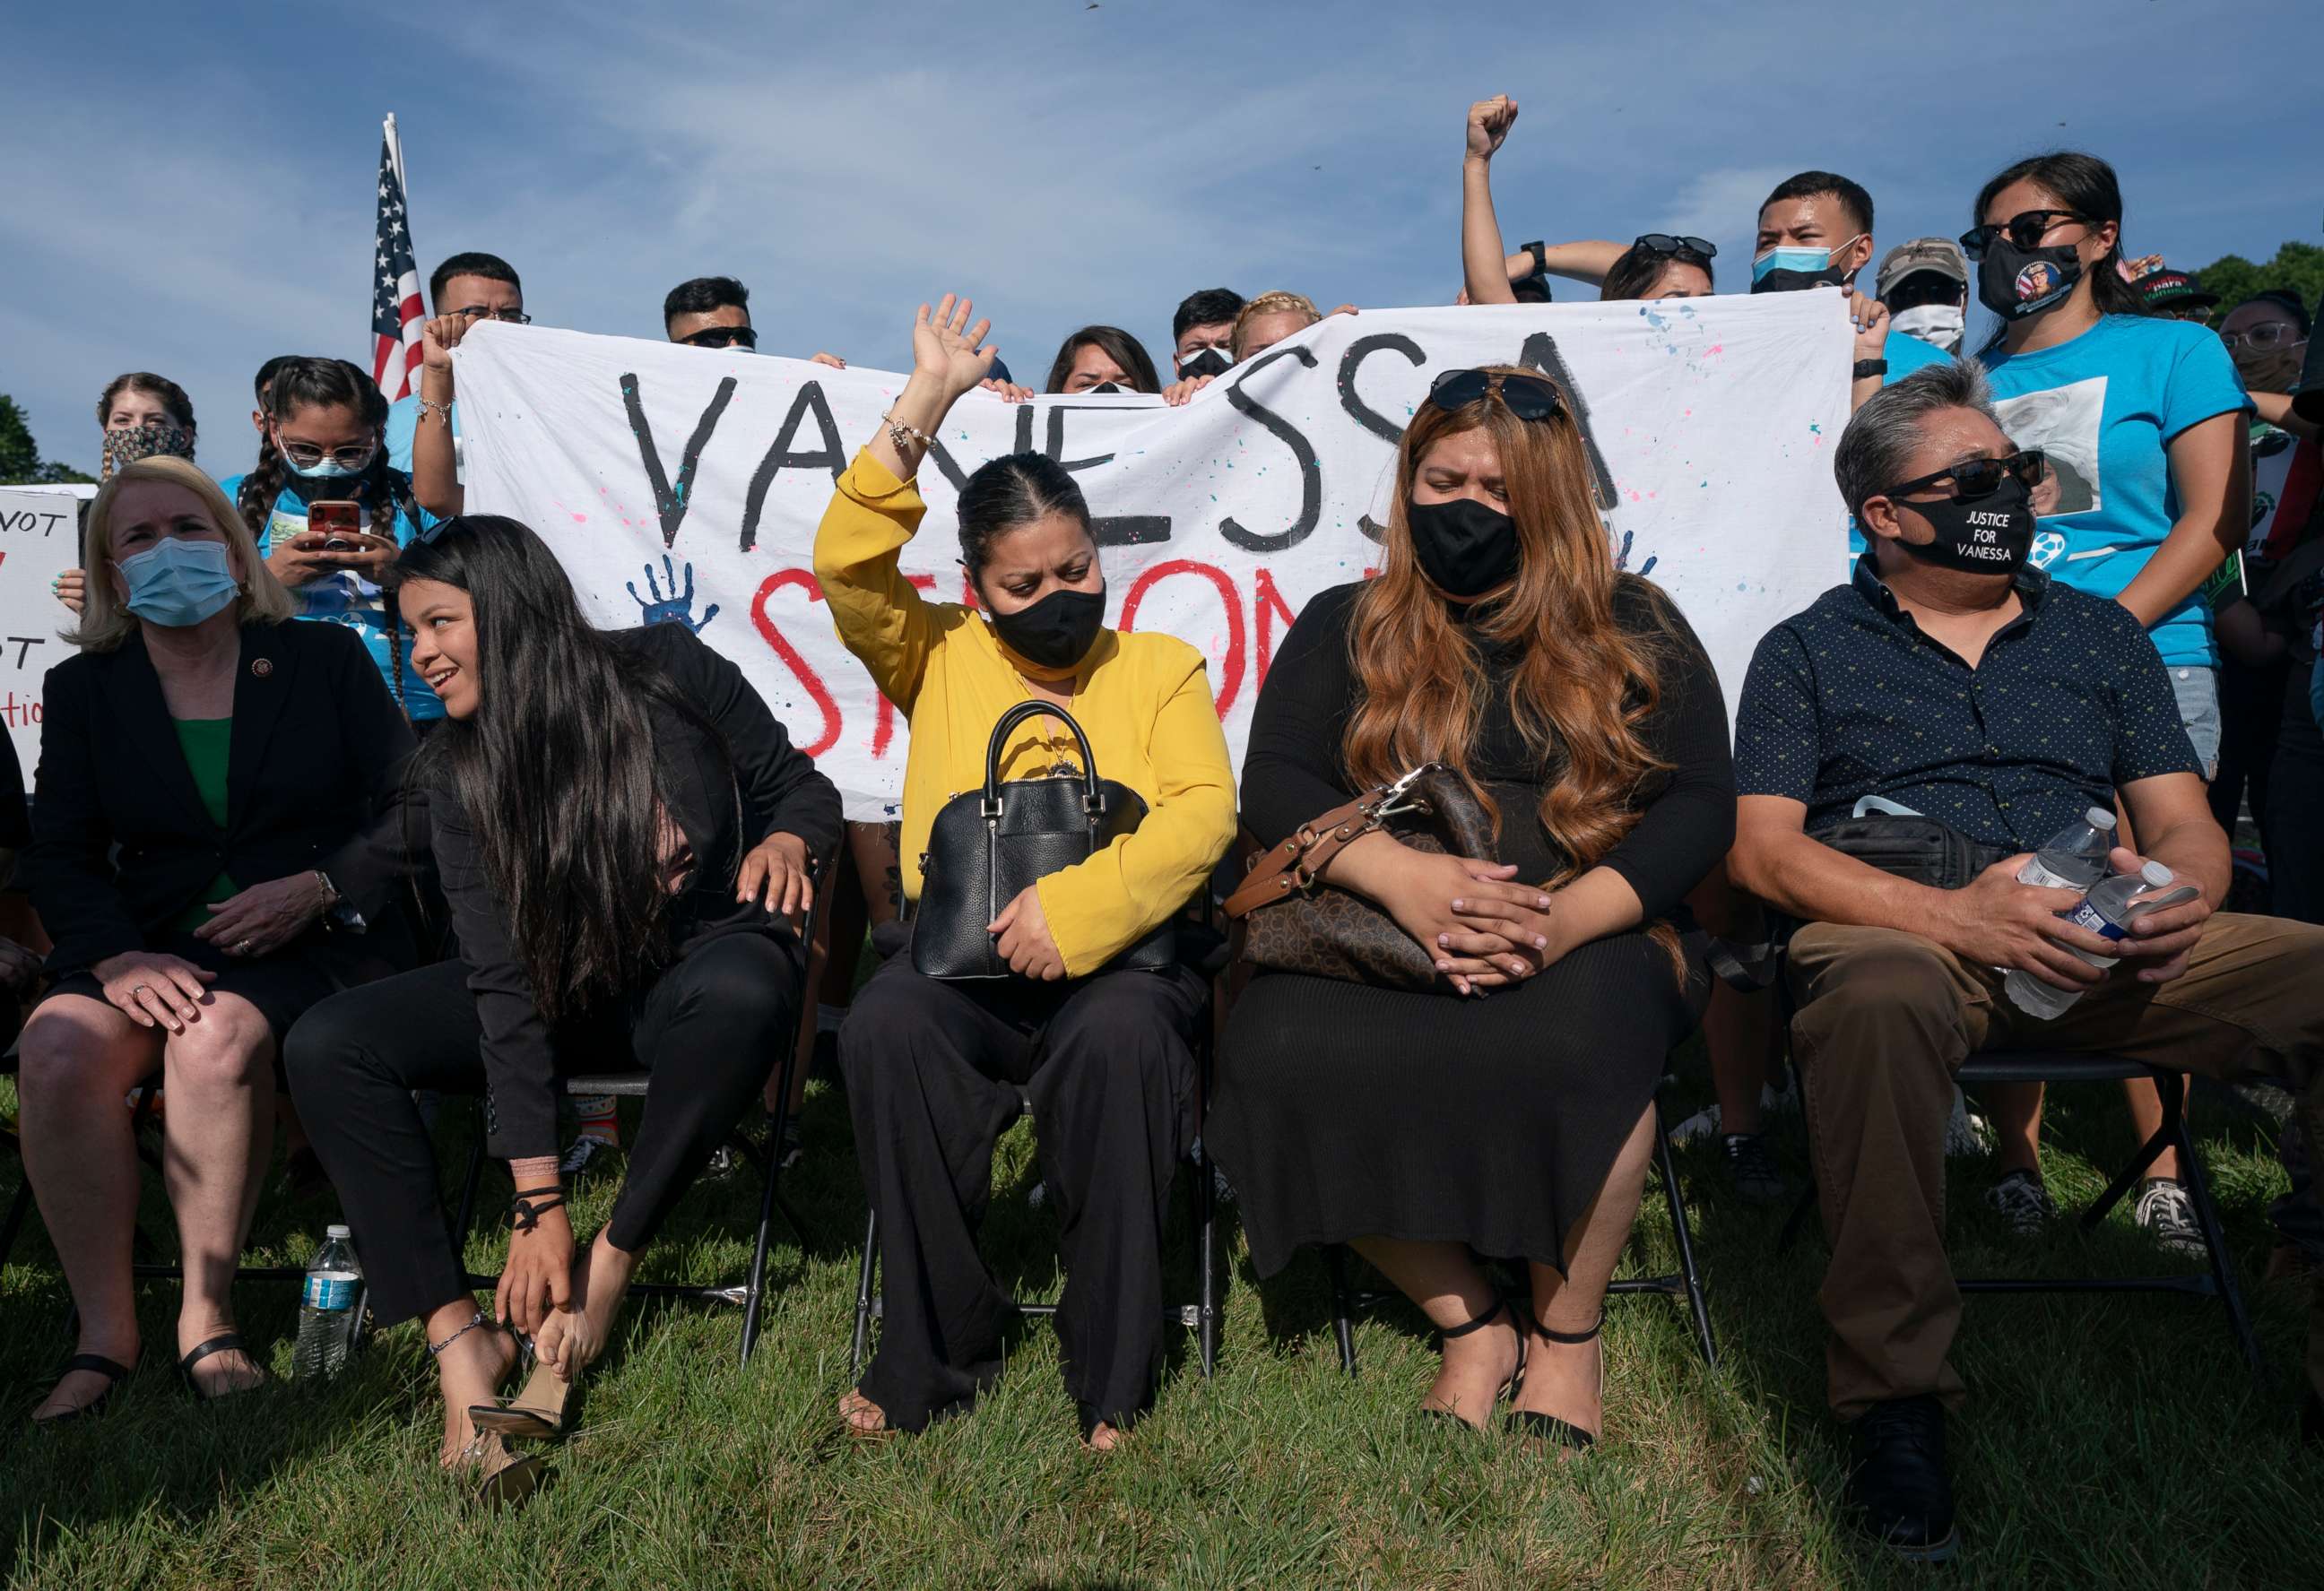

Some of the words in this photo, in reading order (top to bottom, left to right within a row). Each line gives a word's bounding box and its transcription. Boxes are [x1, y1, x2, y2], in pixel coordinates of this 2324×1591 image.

[2153, 281, 2181, 292] para
[1966, 510, 2010, 527] JUSTICE
[1973, 529, 1997, 544] FOR
[1956, 542, 2012, 561] VANESSA
